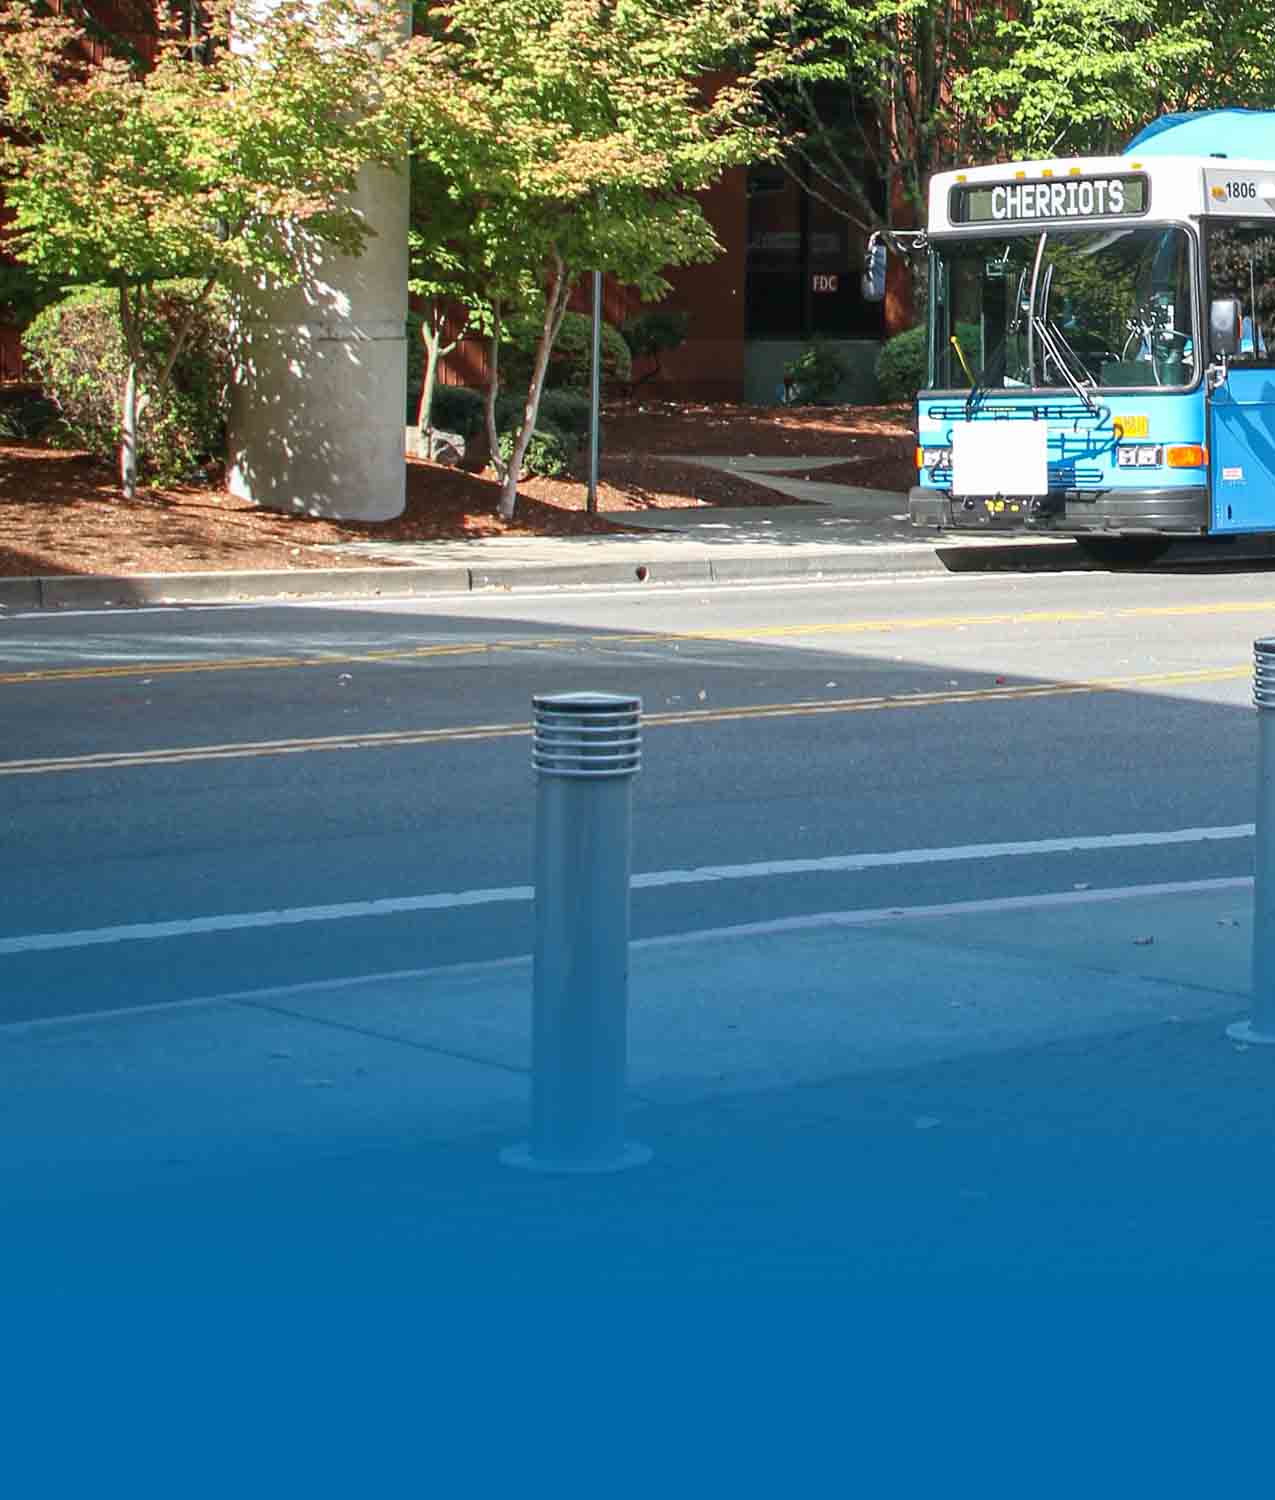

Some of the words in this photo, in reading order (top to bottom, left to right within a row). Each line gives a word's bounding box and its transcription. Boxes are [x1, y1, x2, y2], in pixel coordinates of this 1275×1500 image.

[991, 179, 1124, 219] CHERRIOTS
[1226, 182, 1256, 198] 1806
[812, 274, 838, 292] FDC
